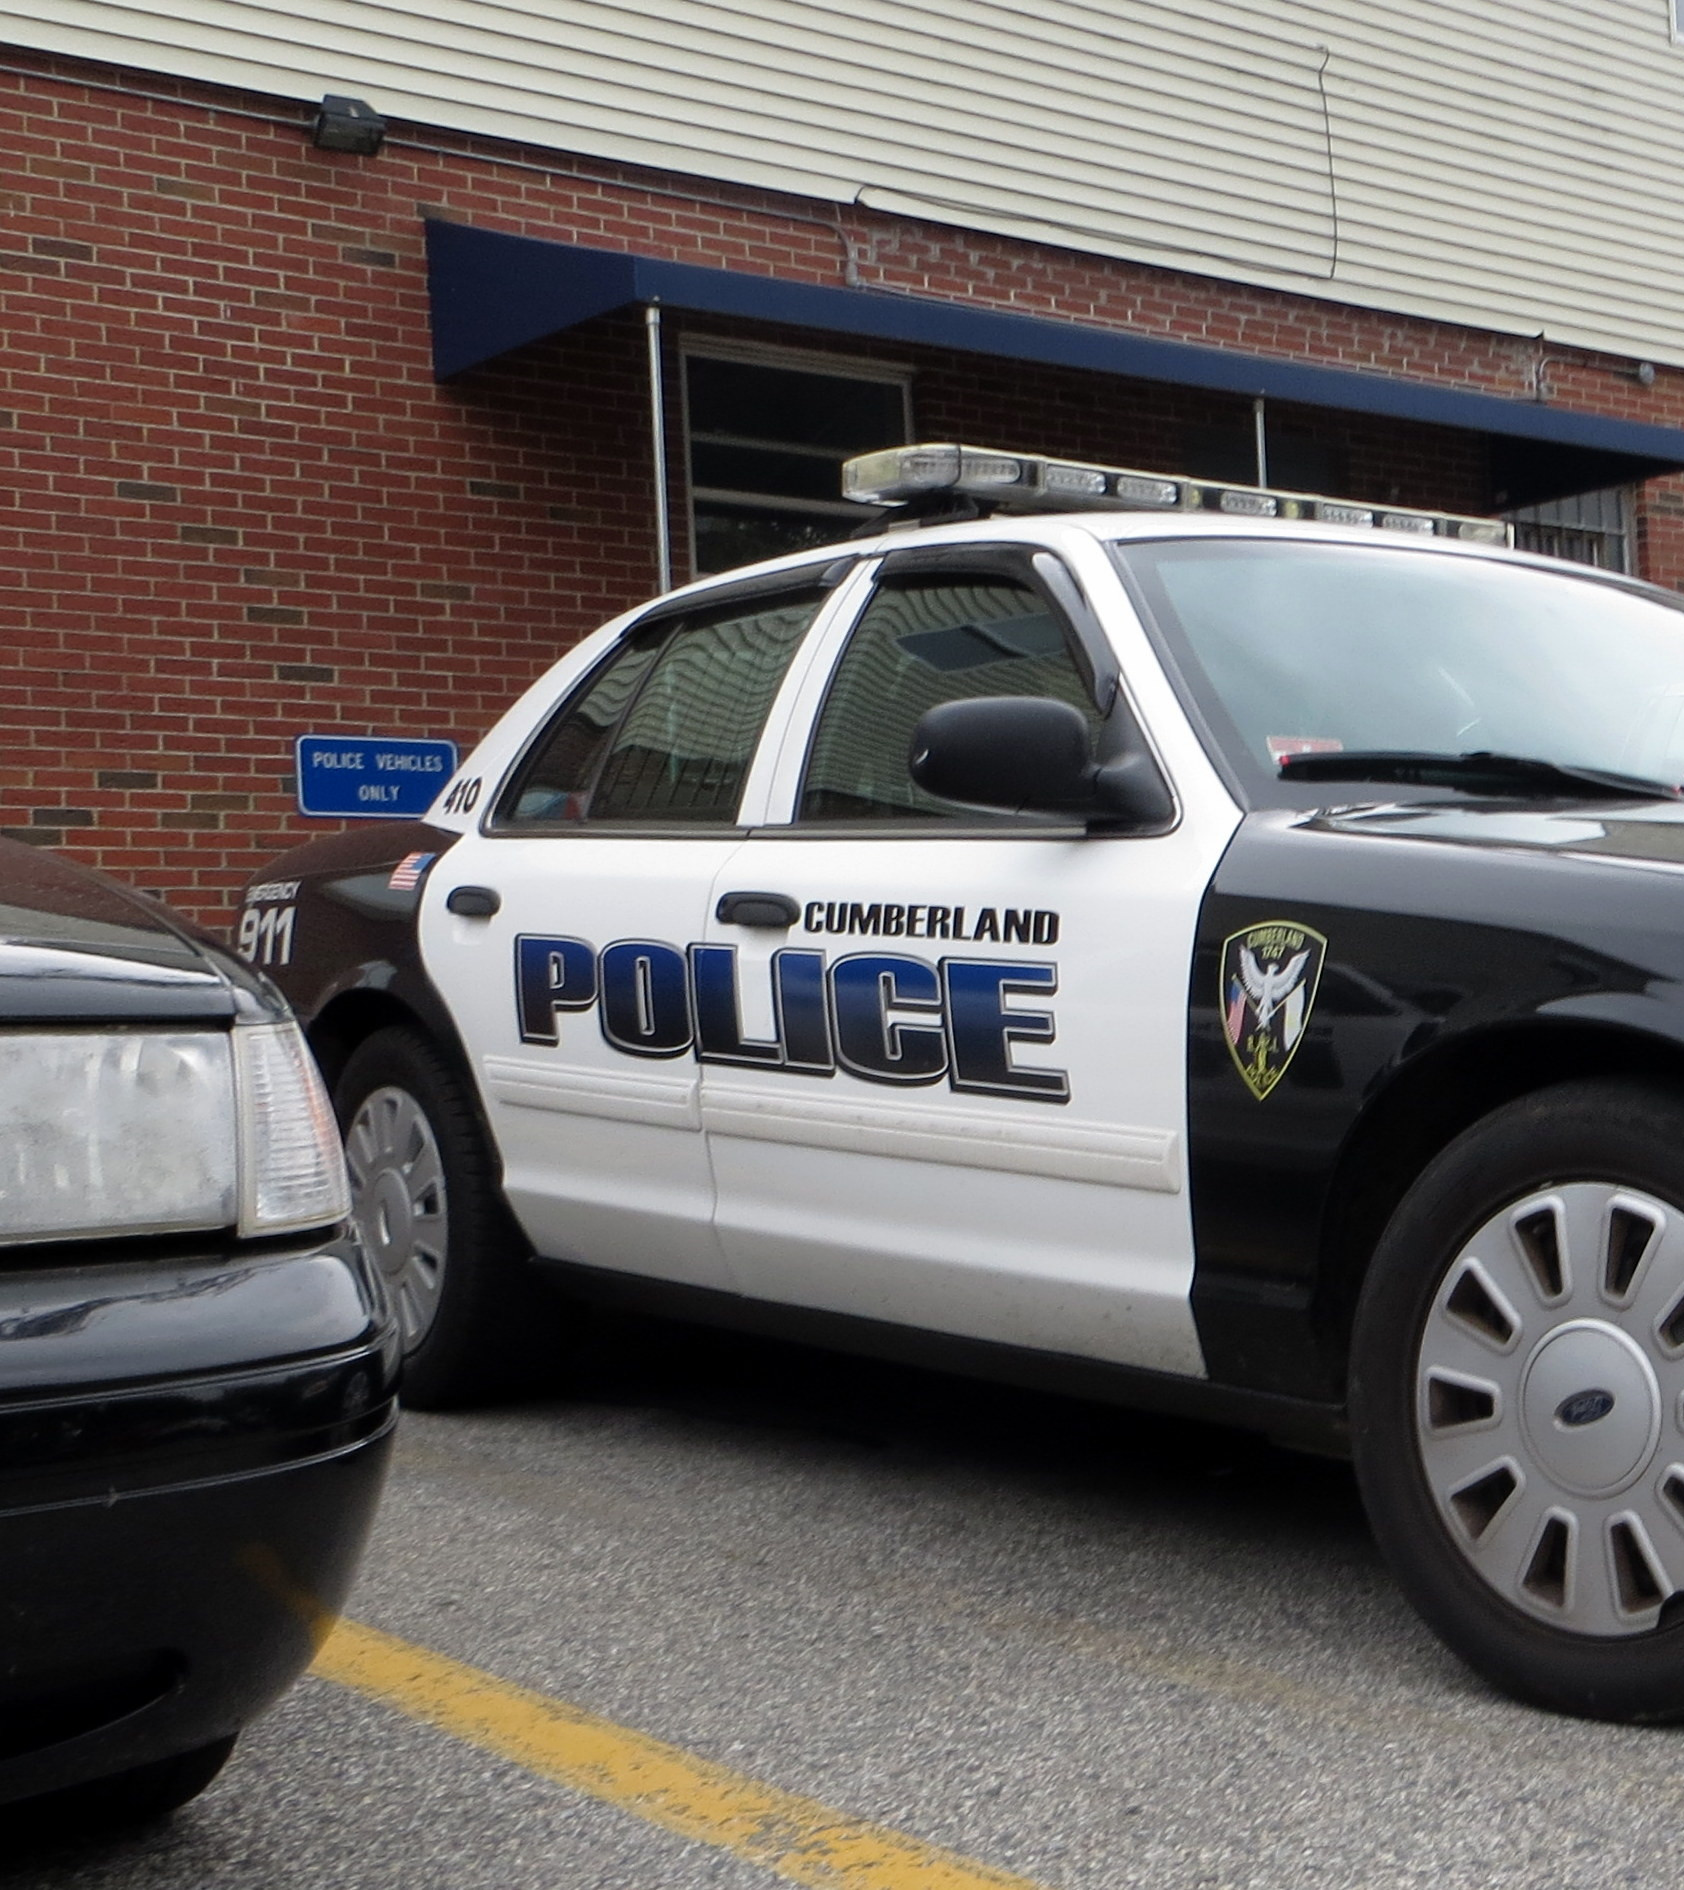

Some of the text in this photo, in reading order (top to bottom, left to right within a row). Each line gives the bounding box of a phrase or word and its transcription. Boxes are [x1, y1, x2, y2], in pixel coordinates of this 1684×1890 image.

[312, 751, 443, 773] POLICE VEHICLES
[358, 784, 401, 803] ONLY
[443, 776, 483, 815] 410
[237, 906, 297, 966] 911
[803, 900, 1061, 945] CUMBERLAND
[514, 931, 1072, 1105] POLICE
